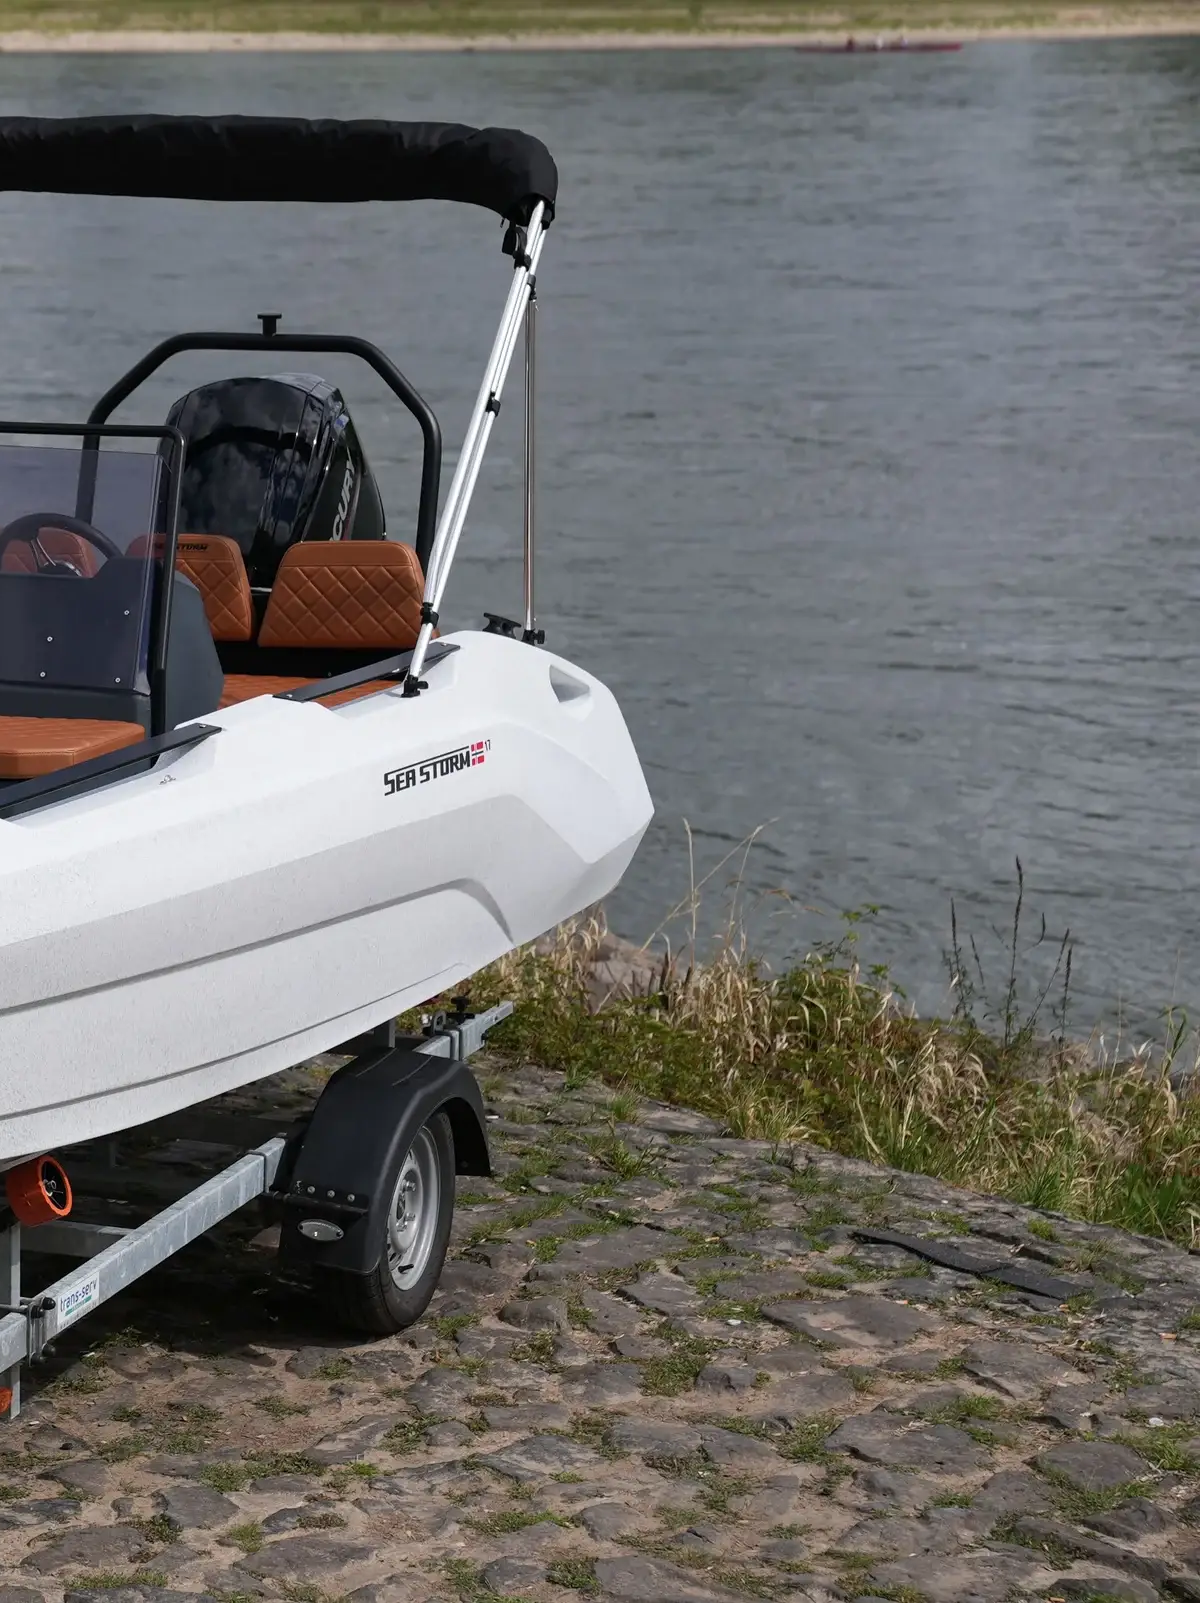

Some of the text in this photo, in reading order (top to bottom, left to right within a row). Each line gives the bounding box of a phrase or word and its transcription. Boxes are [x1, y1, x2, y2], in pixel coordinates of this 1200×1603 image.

[383, 739, 491, 797] SEA STORM 17
[61, 1278, 98, 1312] trans-serv
